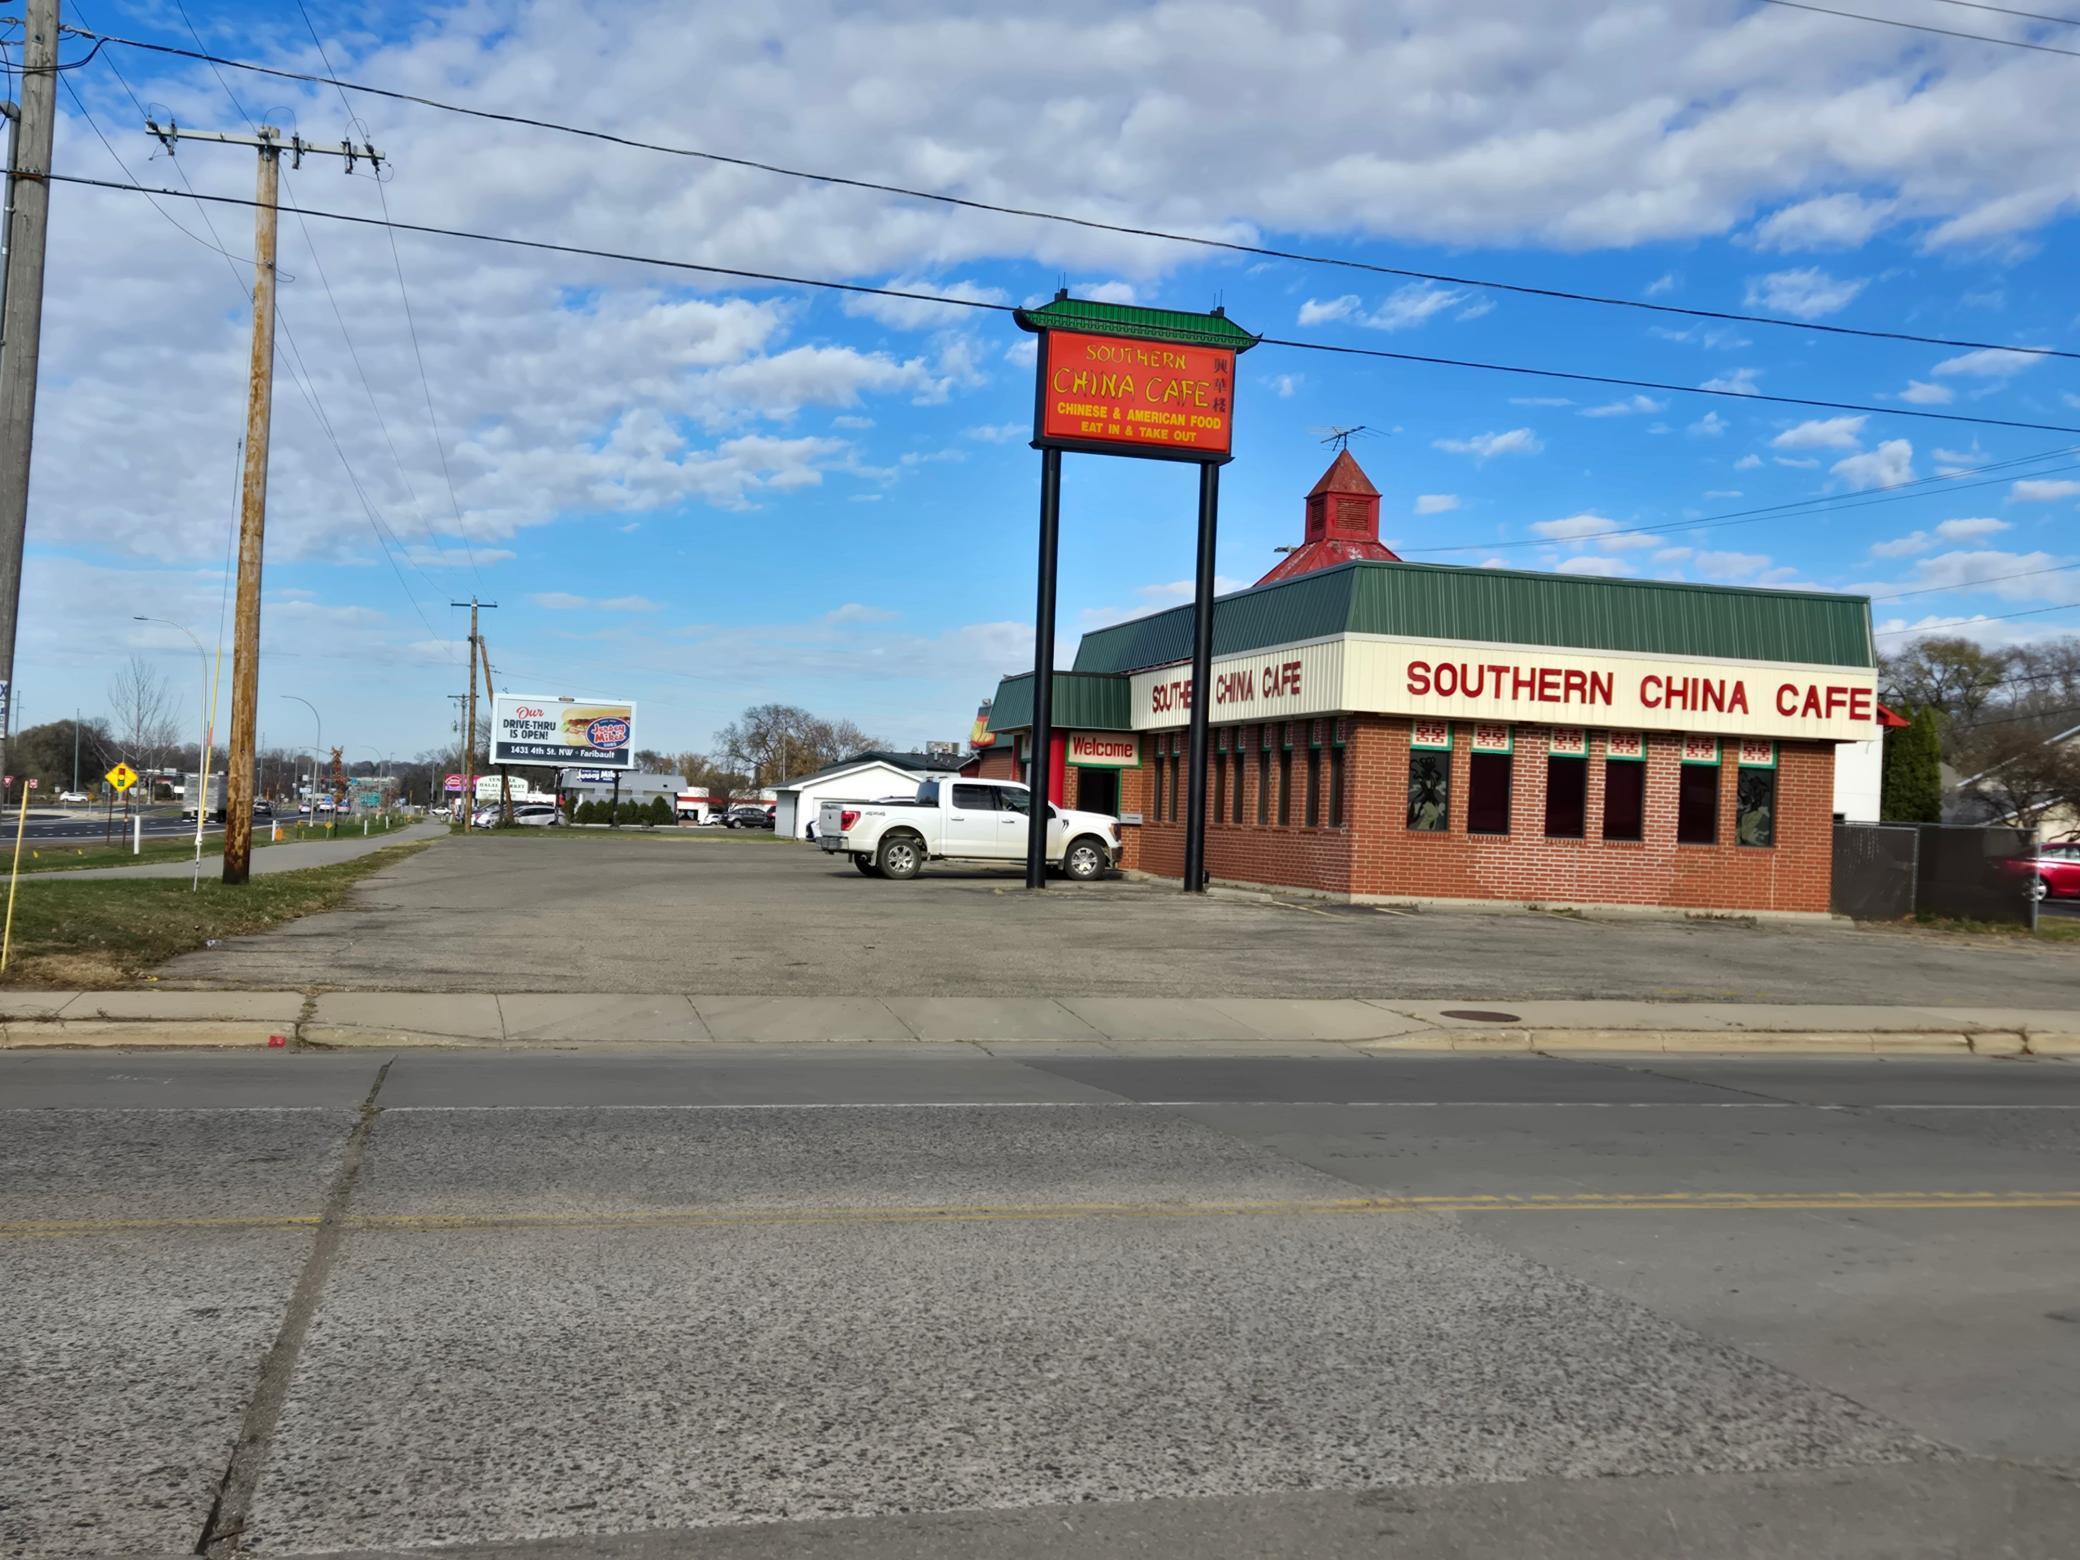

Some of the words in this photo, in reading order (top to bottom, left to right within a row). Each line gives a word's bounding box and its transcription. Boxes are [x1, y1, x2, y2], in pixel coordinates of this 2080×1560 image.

[1086, 344, 1186, 370] SOUTHERN
[1053, 367, 1136, 400] CHINA
[1145, 377, 1210, 408] CAFE
[1057, 401, 1108, 418] CHINESE
[1112, 407, 1121, 420] &
[1127, 408, 1186, 426] AMERICAN
[1190, 415, 1222, 430] FOOD
[1081, 421, 1103, 433] EAT
[1108, 423, 1120, 435] IN
[1125, 424, 1134, 436] &
[1139, 426, 1168, 440] TAKE
[1174, 430, 1197, 442] OUT
[1152, 679, 1193, 714] SOUTHE
[1216, 670, 1254, 705] CHINA
[1262, 660, 1301, 699] CAFE
[1406, 660, 1614, 706] SOUTHERN
[1639, 674, 1749, 715] CHINA
[1775, 683, 1873, 721] CAFE
[516, 706, 544, 720] Our
[503, 719, 556, 731] DRIVE-THRU
[510, 729, 518, 739] IS
[521, 730, 548, 740] OPEN!
[591, 723, 626, 734] Jersey
[530, 746, 544, 755] 4th
[558, 749, 573, 757] NW
[580, 750, 615, 759] Faribault
[1073, 736, 1133, 758] Welcome
